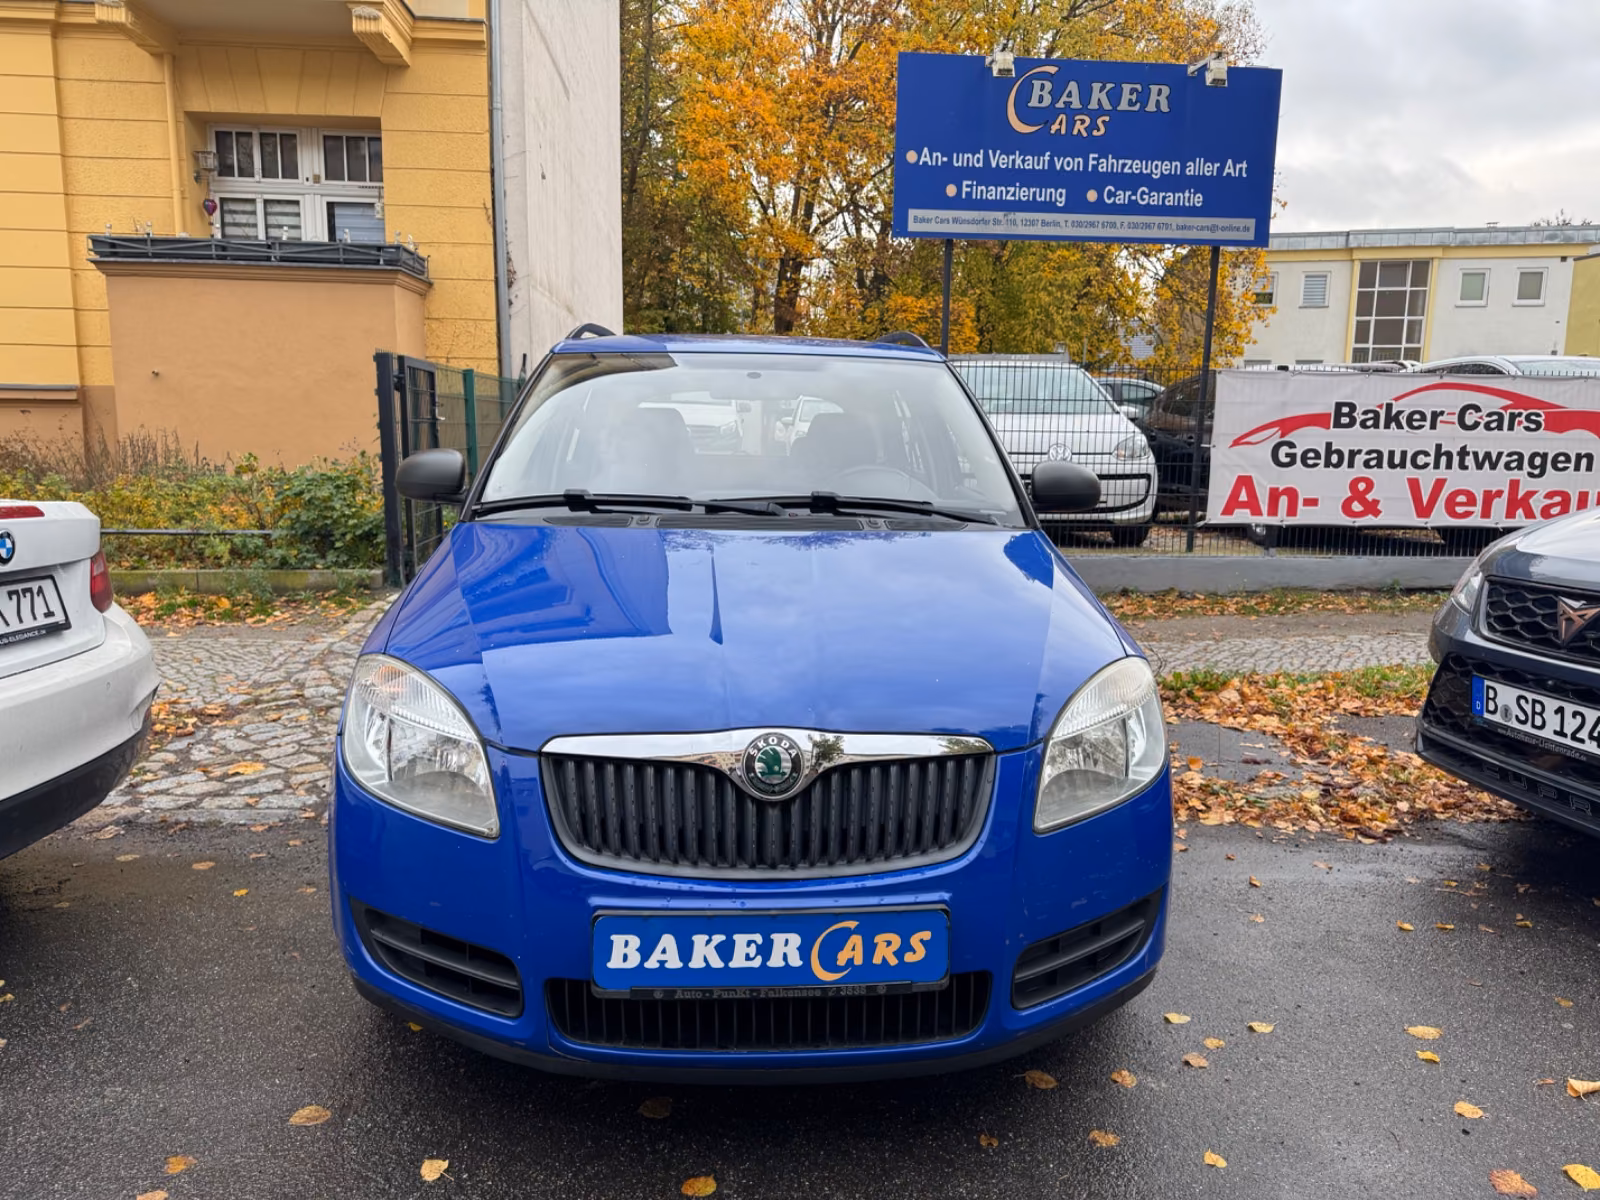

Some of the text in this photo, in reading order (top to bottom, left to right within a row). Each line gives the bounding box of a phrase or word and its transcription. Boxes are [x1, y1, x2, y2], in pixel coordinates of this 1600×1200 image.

[1027, 79, 1171, 113] BAKER
[919, 146, 1247, 179] An- und Verkauf von Fahrzeugen aller Art
[961, 180, 1066, 206] Finanzierung
[1103, 185, 1203, 207] Car-Garantie
[913, 215, 932, 225] Baker
[935, 215, 950, 225] Cars
[1176, 223, 1251, 233] baker-cars@t-online.de
[1271, 440, 1594, 478] Gebrauchtwagen
[1220, 474, 1320, 518] An-
[1341, 476, 1383, 519] &
[7, 585, 55, 624] 771
[1486, 685, 1498, 715] B
[1515, 694, 1546, 730] SB
[606, 932, 803, 969] BAKER
[674, 989, 702, 999] Auto
